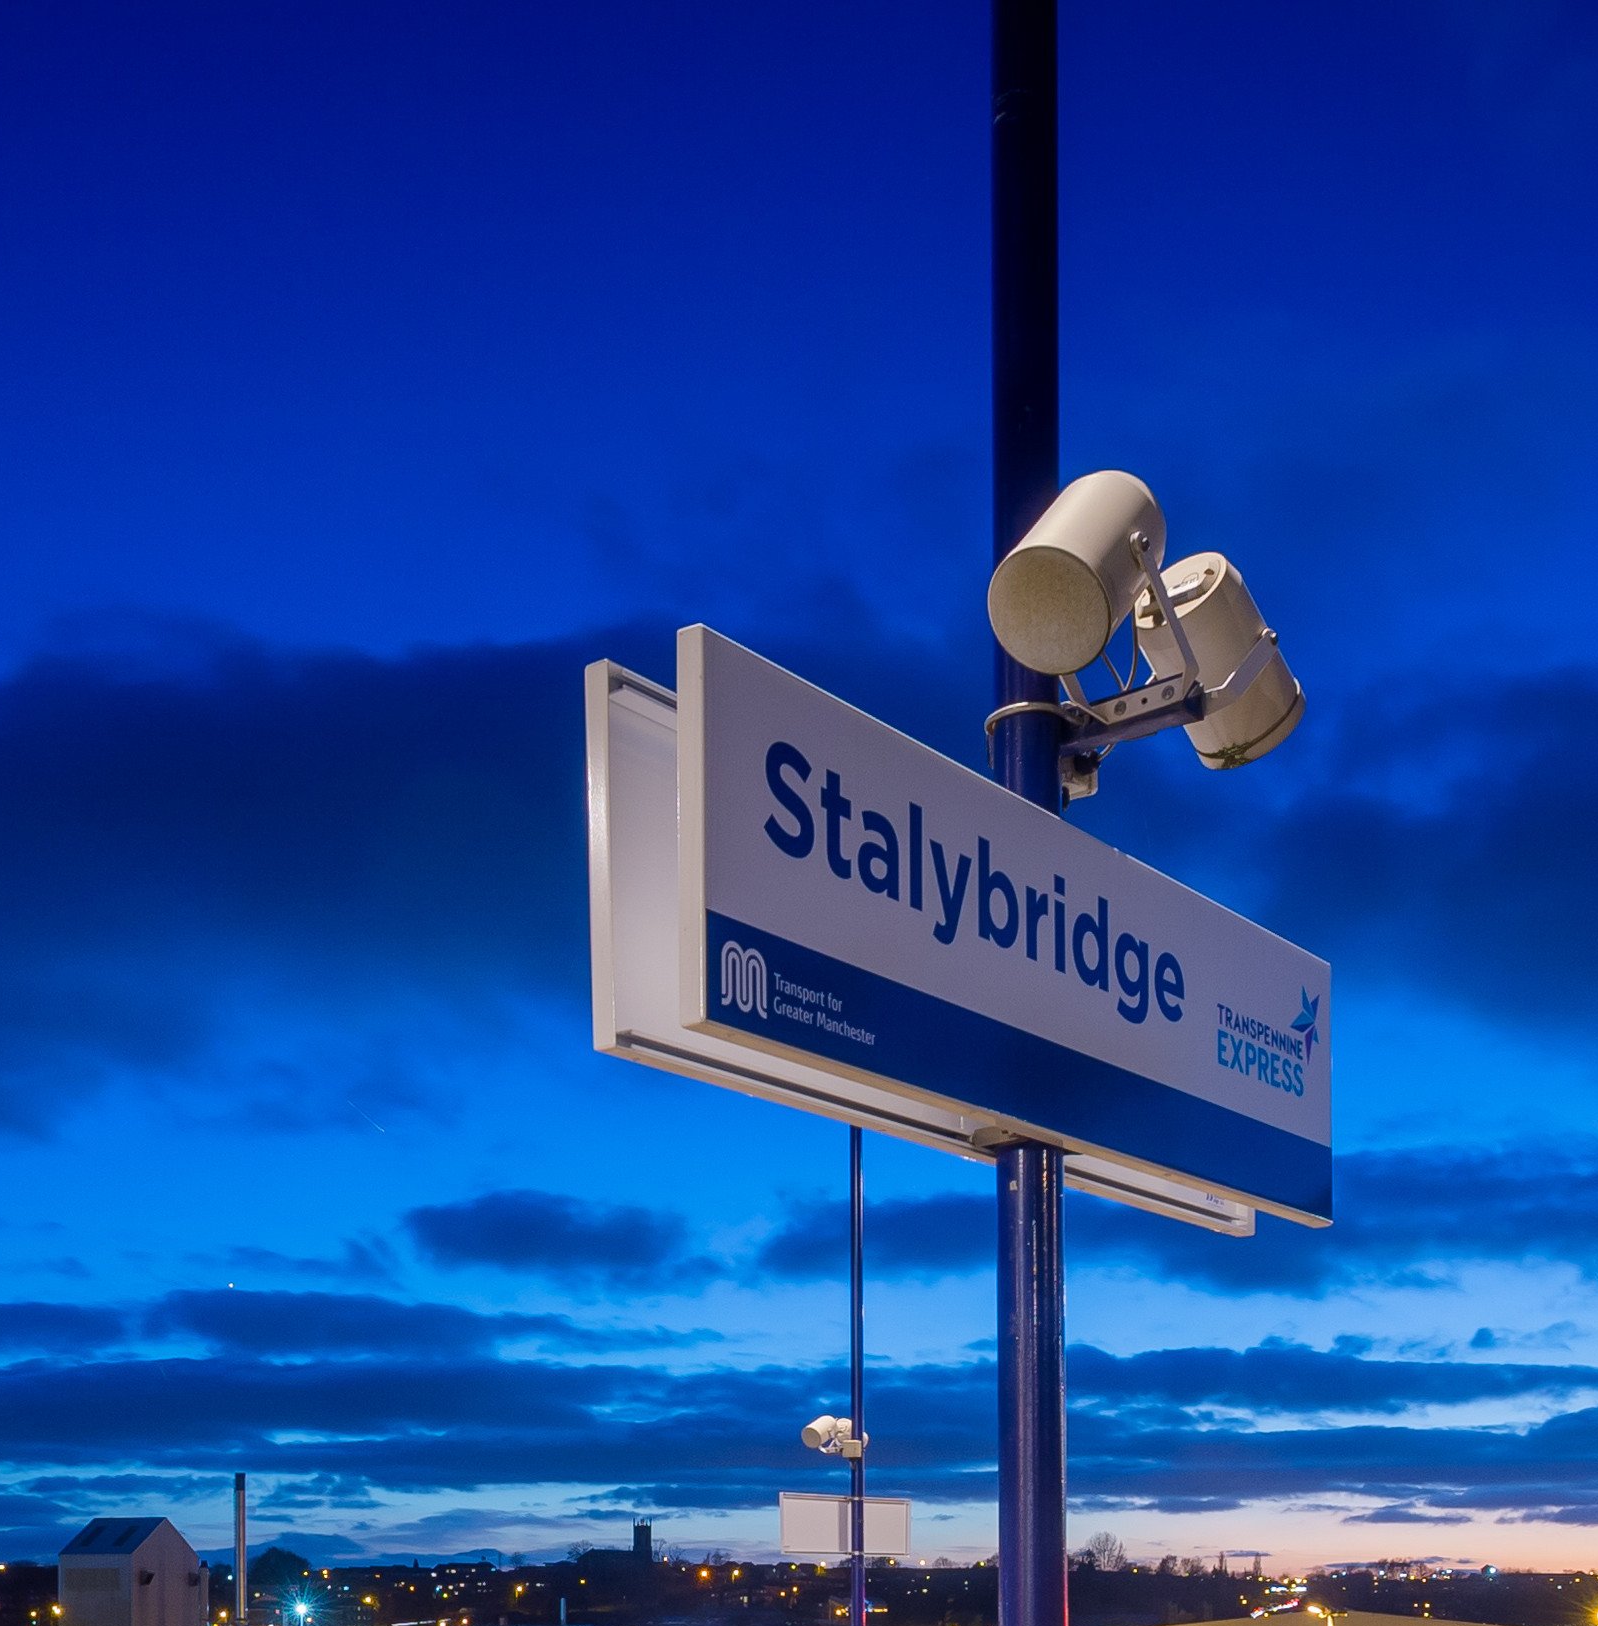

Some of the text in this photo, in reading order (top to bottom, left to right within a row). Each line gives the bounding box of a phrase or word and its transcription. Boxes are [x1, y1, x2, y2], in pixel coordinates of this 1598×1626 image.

[763, 740, 1185, 1025] Stalybridge
[773, 972, 843, 1013] Transport for
[773, 996, 876, 1046] Greater Manchester
[1216, 1002, 1303, 1061] TRANSPENNINE
[1217, 1028, 1304, 1097] EXPRESS
